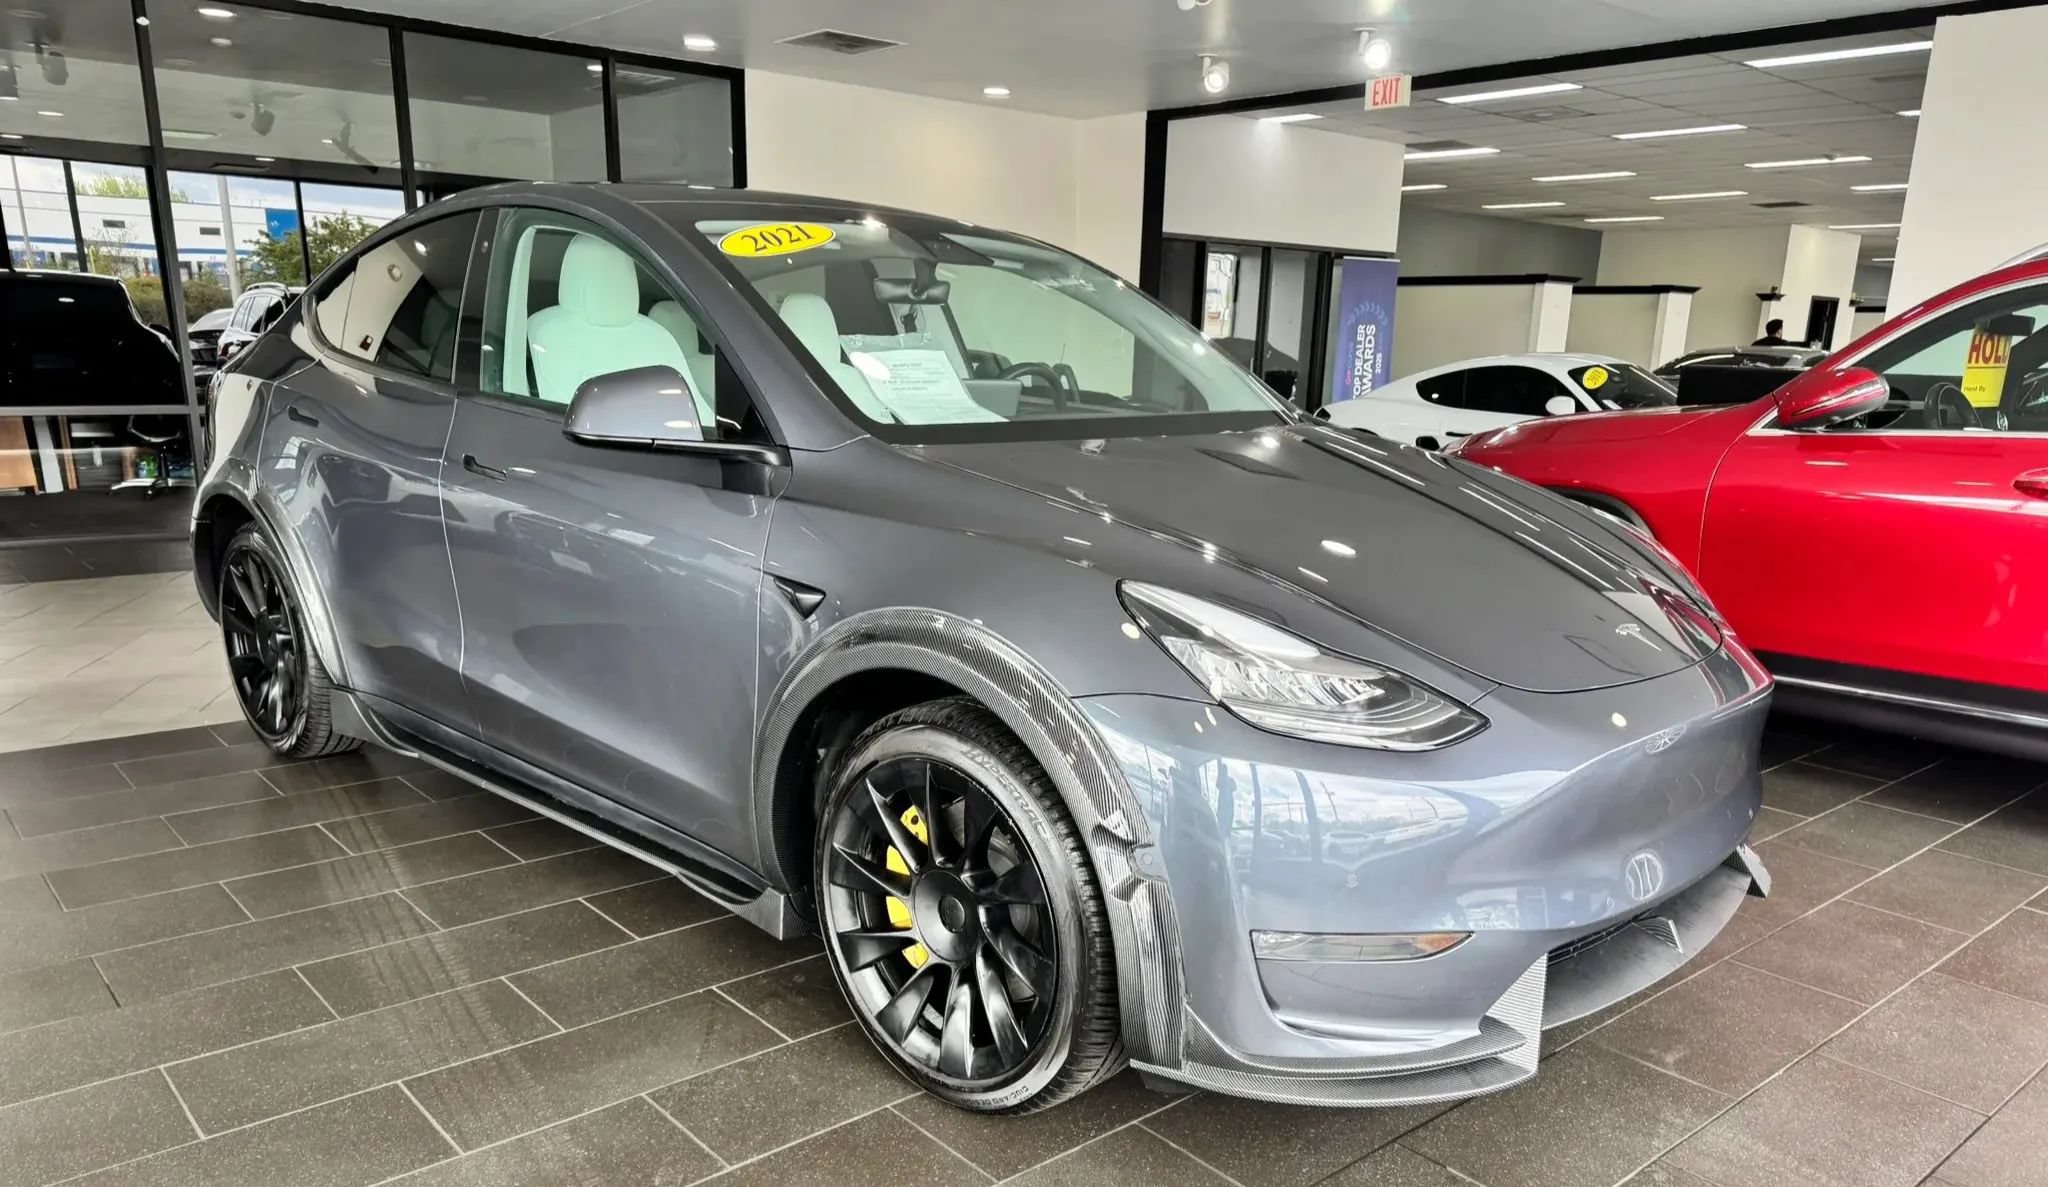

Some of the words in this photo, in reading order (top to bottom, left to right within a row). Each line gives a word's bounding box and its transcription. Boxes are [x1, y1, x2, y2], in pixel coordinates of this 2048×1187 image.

[1372, 77, 1402, 106] EXIT
[741, 225, 815, 252] 2021
[1355, 324, 1366, 376] DEALER
